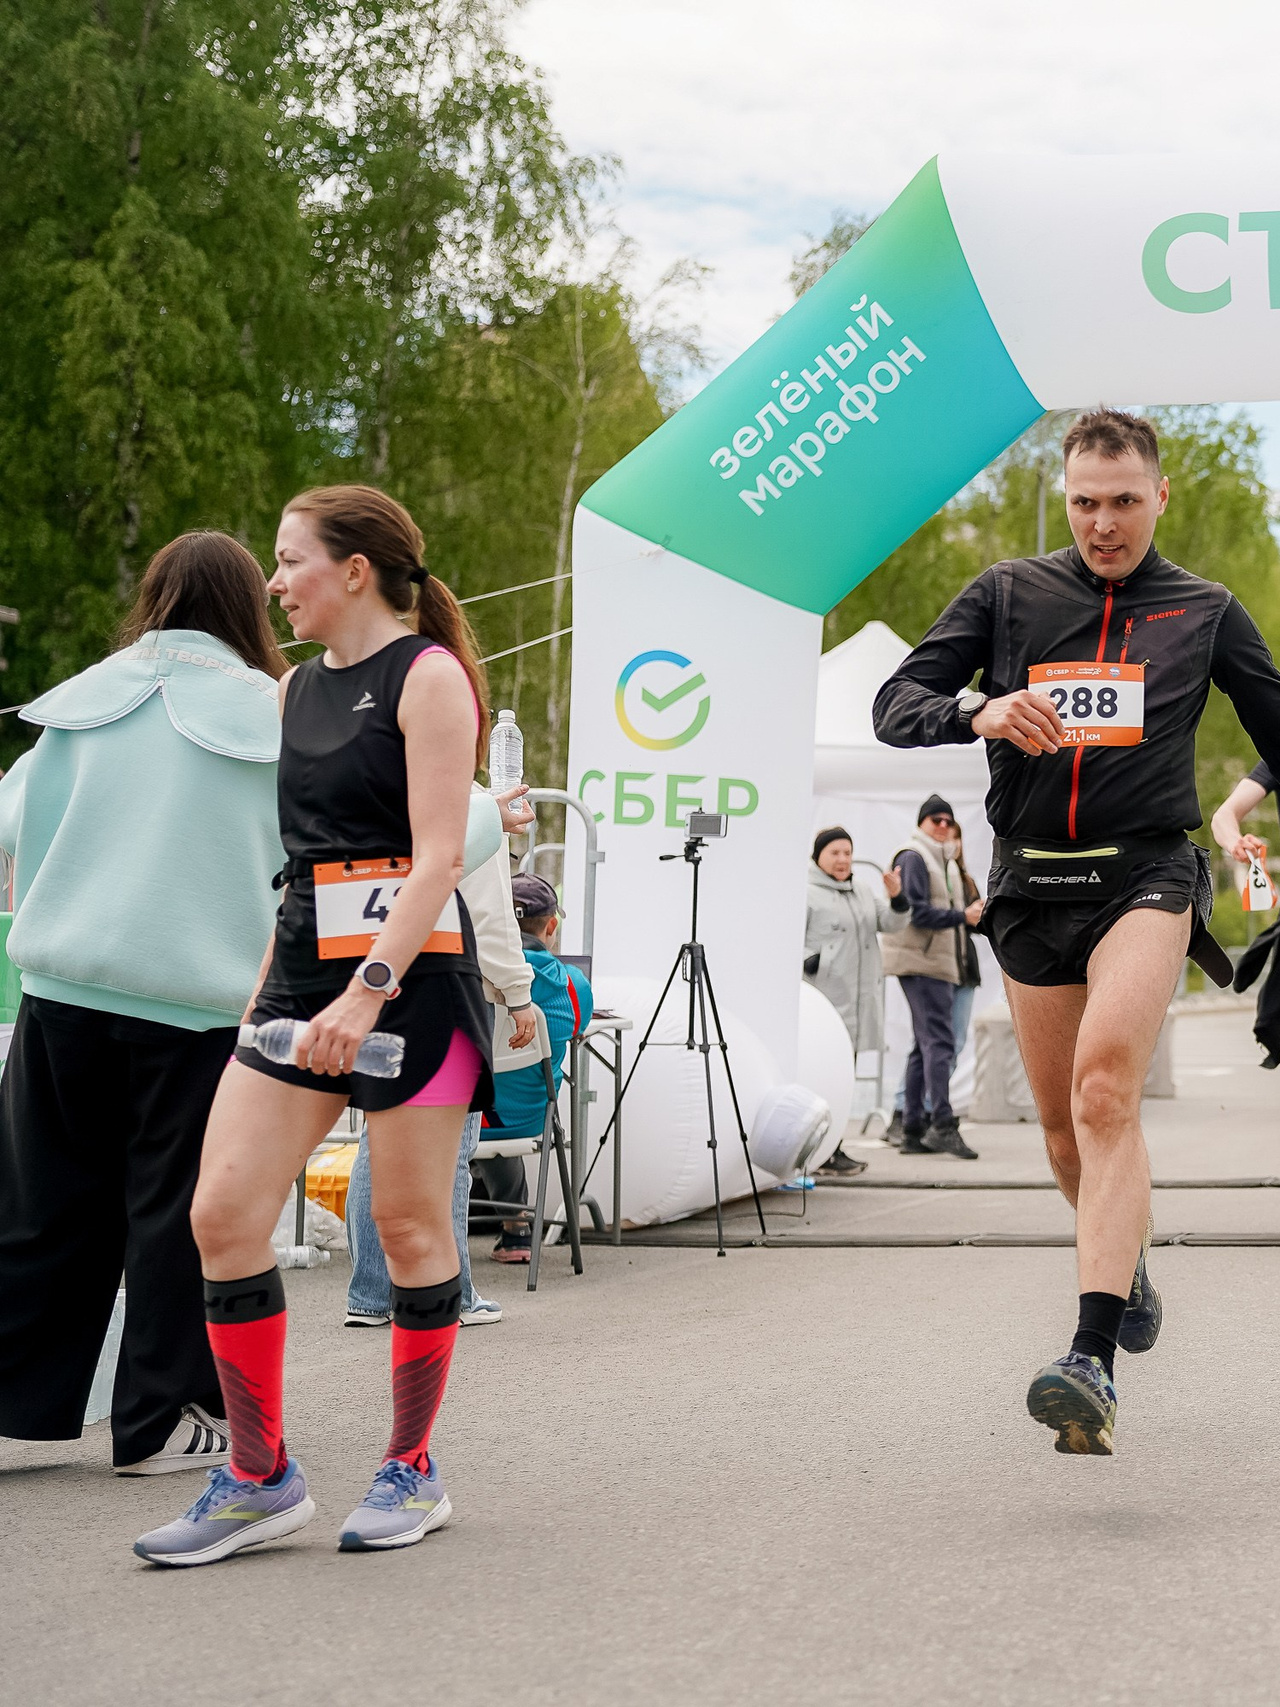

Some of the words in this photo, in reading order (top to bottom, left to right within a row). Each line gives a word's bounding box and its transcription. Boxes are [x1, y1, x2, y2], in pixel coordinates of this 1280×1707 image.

[709, 294, 894, 480] зелёный
[738, 335, 927, 517] марафон
[1049, 687, 1118, 719] 288
[578, 769, 759, 828] СБЕР
[1028, 876, 1087, 884] FISCHER
[363, 886, 402, 923] 4
